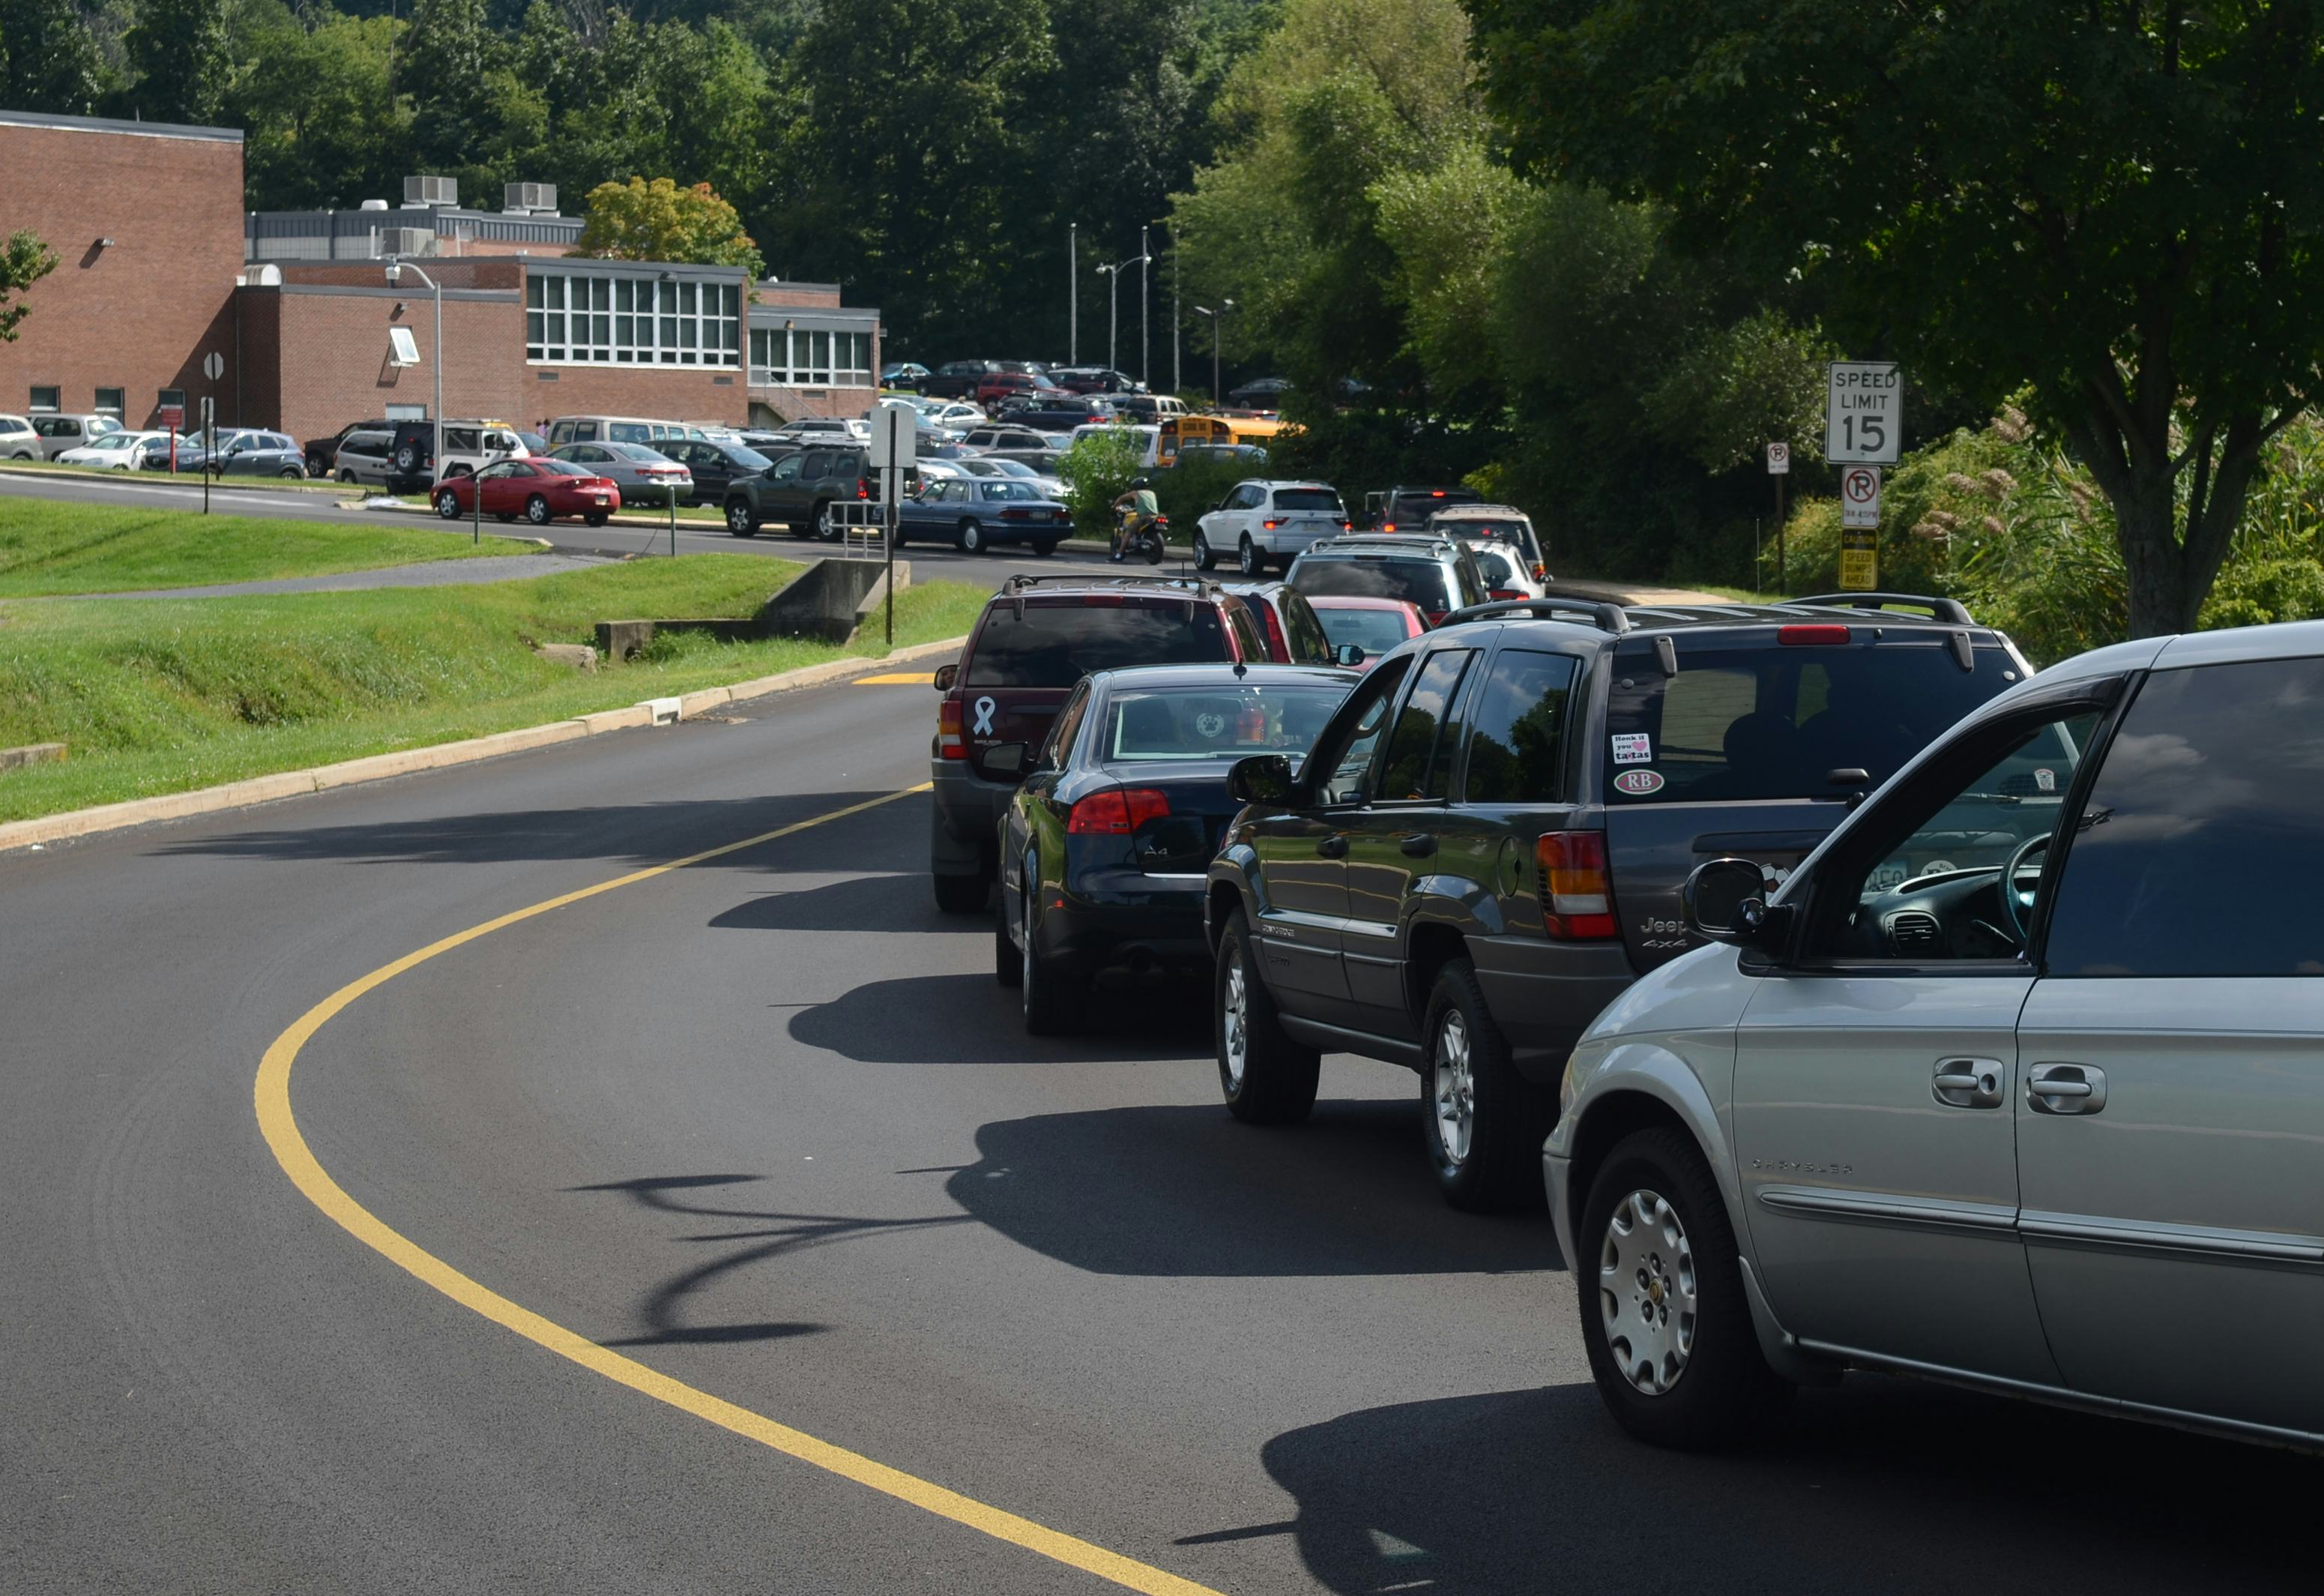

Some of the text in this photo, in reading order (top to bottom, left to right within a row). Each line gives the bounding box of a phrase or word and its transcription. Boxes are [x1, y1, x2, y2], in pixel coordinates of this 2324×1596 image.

[1835, 373, 1896, 388] SPEED
[1841, 394, 1889, 409] LIMIT
[1843, 415, 1885, 452] 15
[1844, 534, 1875, 543] CAUTION
[1846, 552, 1871, 562] SPEED
[1845, 563, 1872, 573] BUMPS
[1845, 574, 1871, 584] AHEAD
[1628, 774, 1653, 787] RB
[1144, 845, 1168, 855] A4
[1640, 918, 1686, 936] Jeep
[1752, 1159, 1853, 1175] CHRYSLER
